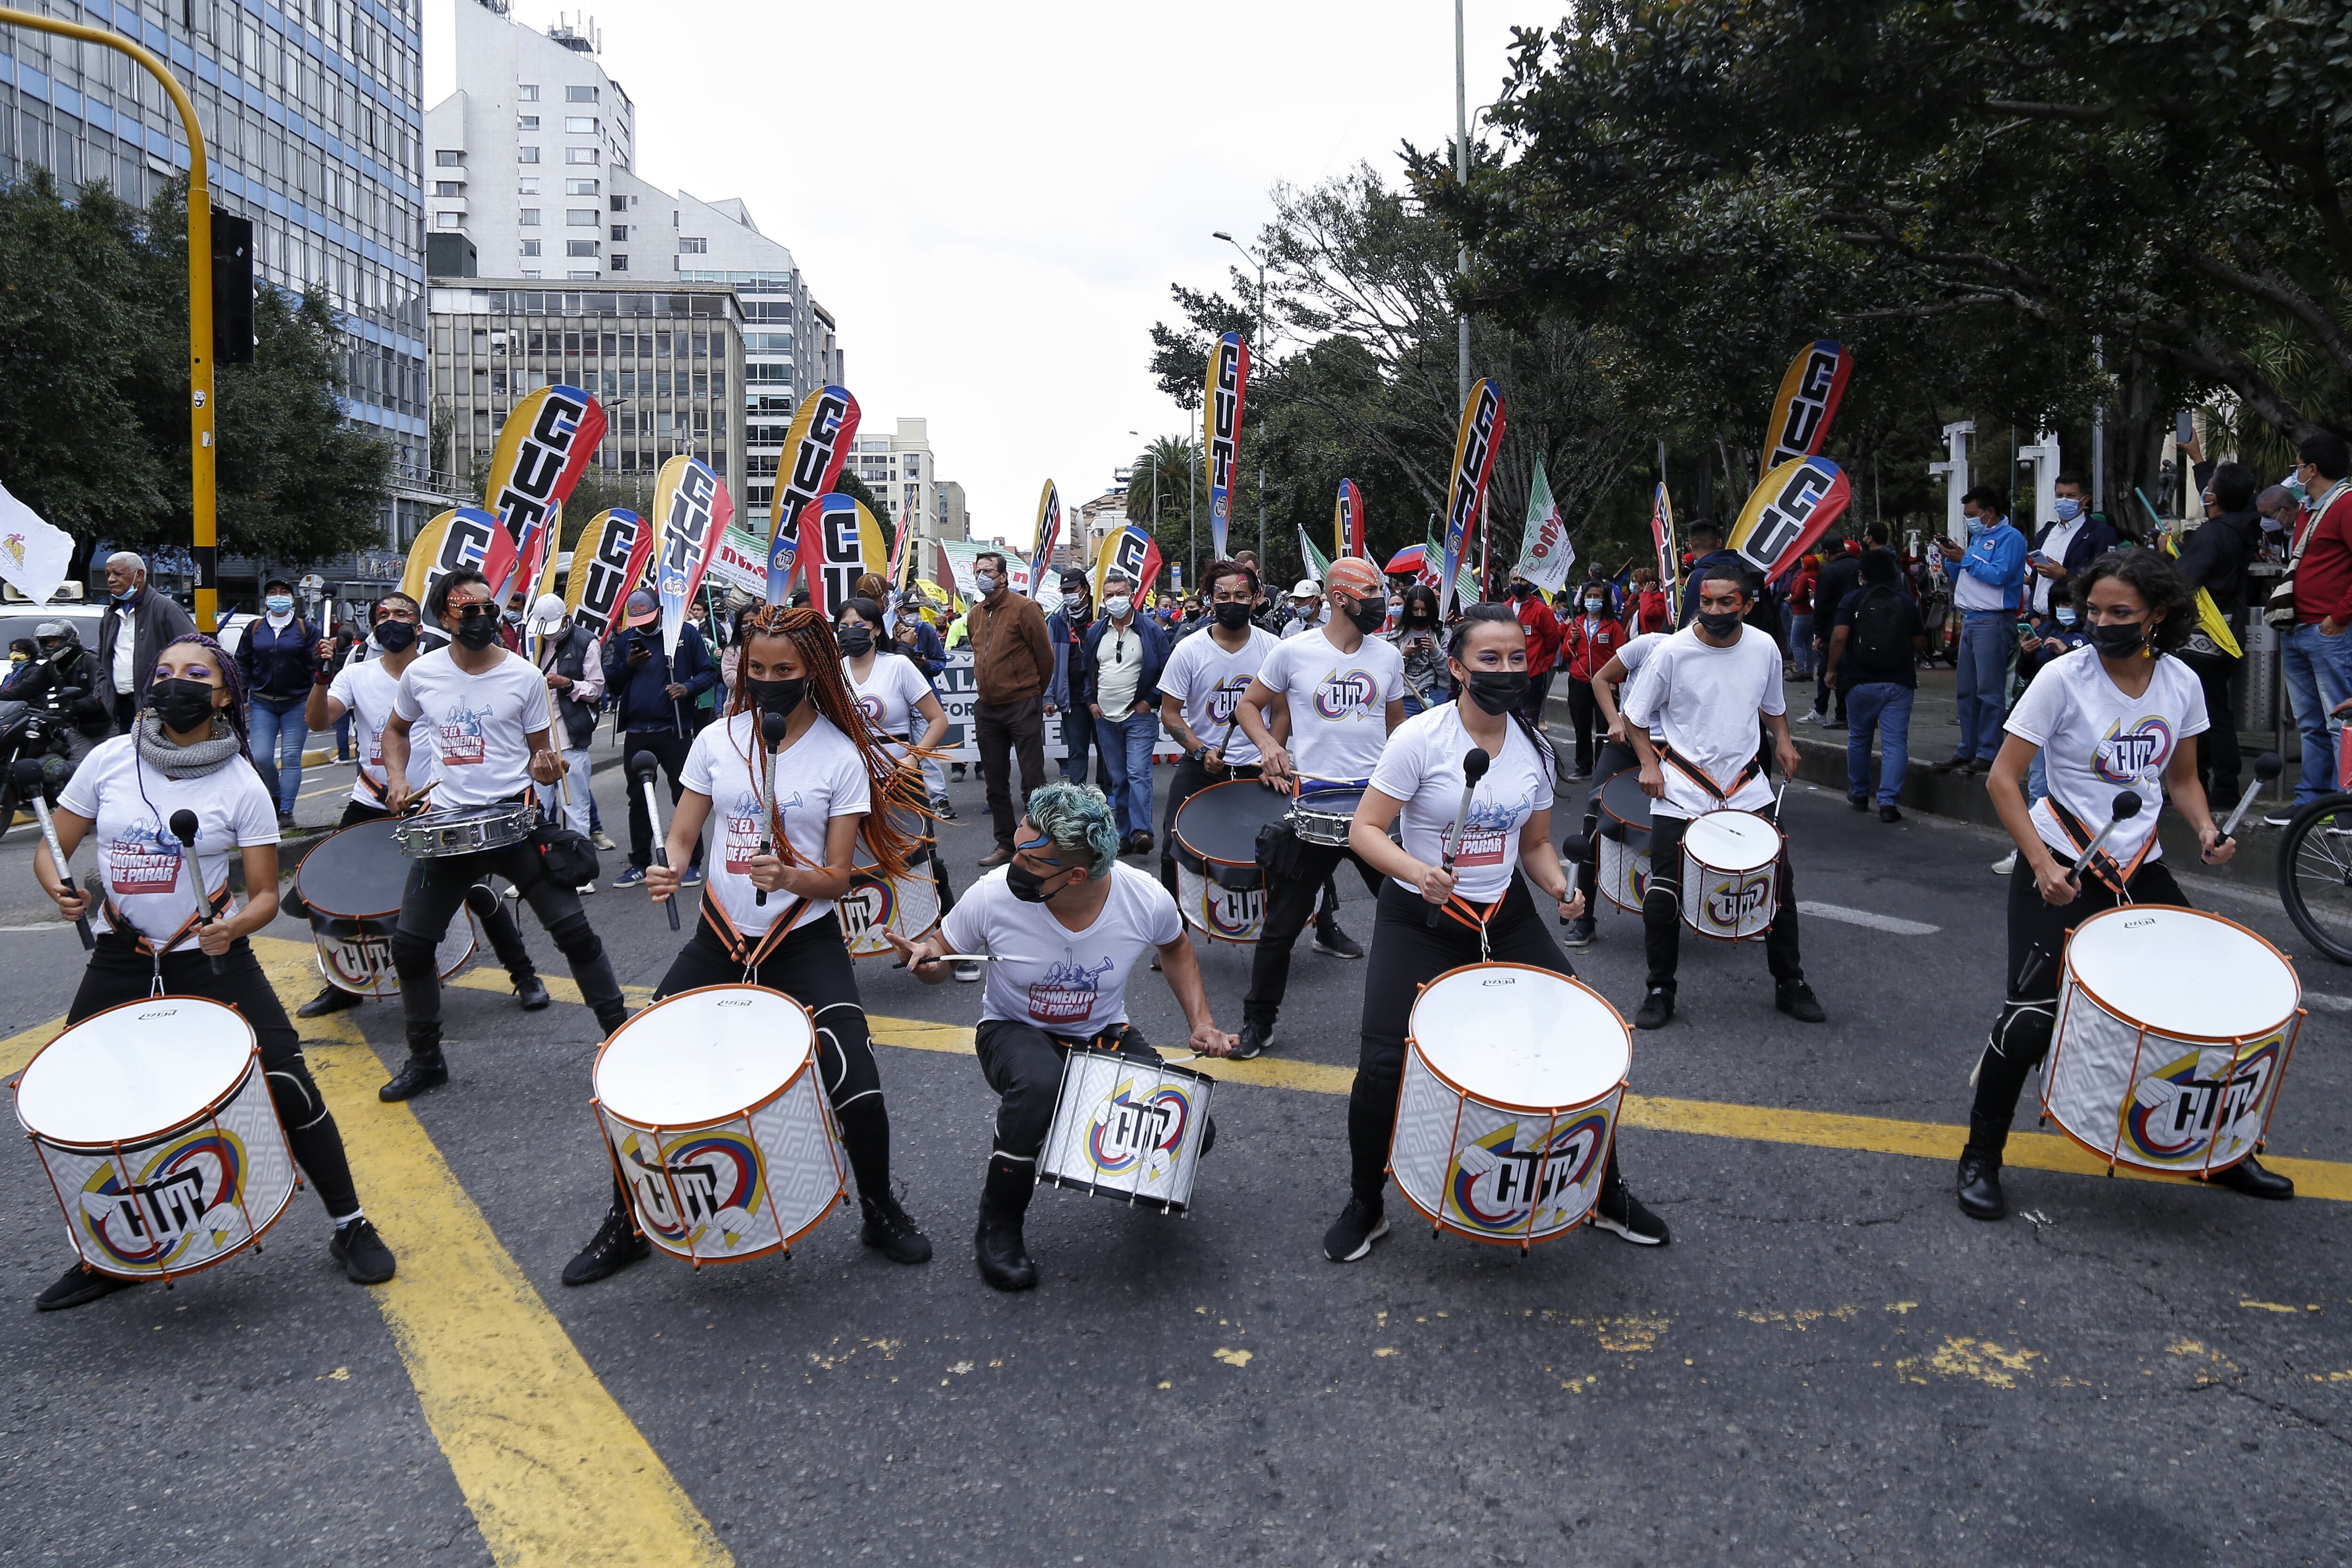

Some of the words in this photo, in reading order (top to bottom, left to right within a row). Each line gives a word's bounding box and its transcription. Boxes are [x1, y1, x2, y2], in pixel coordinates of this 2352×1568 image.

[1210, 341, 1240, 490] CUT
[496, 394, 587, 550] CUT
[1451, 385, 1498, 532] CUT
[660, 462, 717, 578] CUT
[1330, 680, 1363, 708] CUT
[442, 736, 482, 748] MOMENTO
[450, 726, 458, 737] EL
[444, 747, 451, 758] DE
[451, 746, 481, 757] PARAR
[2112, 735, 2156, 775] CUT
[739, 819, 751, 833] EL
[112, 853, 177, 868] MOMENTO
[727, 846, 742, 862] DE
[1461, 838, 1502, 855] PARAR
[112, 868, 127, 883] DE
[127, 867, 174, 883] PARAR
[1723, 890, 1758, 918] CUT
[338, 940, 390, 974] CUT
[1030, 990, 1095, 1005] MOMENTO
[1030, 1003, 1046, 1015] DE
[1045, 1003, 1089, 1017] PARAR
[2166, 1077, 2259, 1138] CUT
[1109, 1102, 1170, 1158] CUT
[1490, 1147, 1578, 1211] CUT
[113, 1168, 205, 1243] CUT
[641, 1164, 718, 1227] CUT
